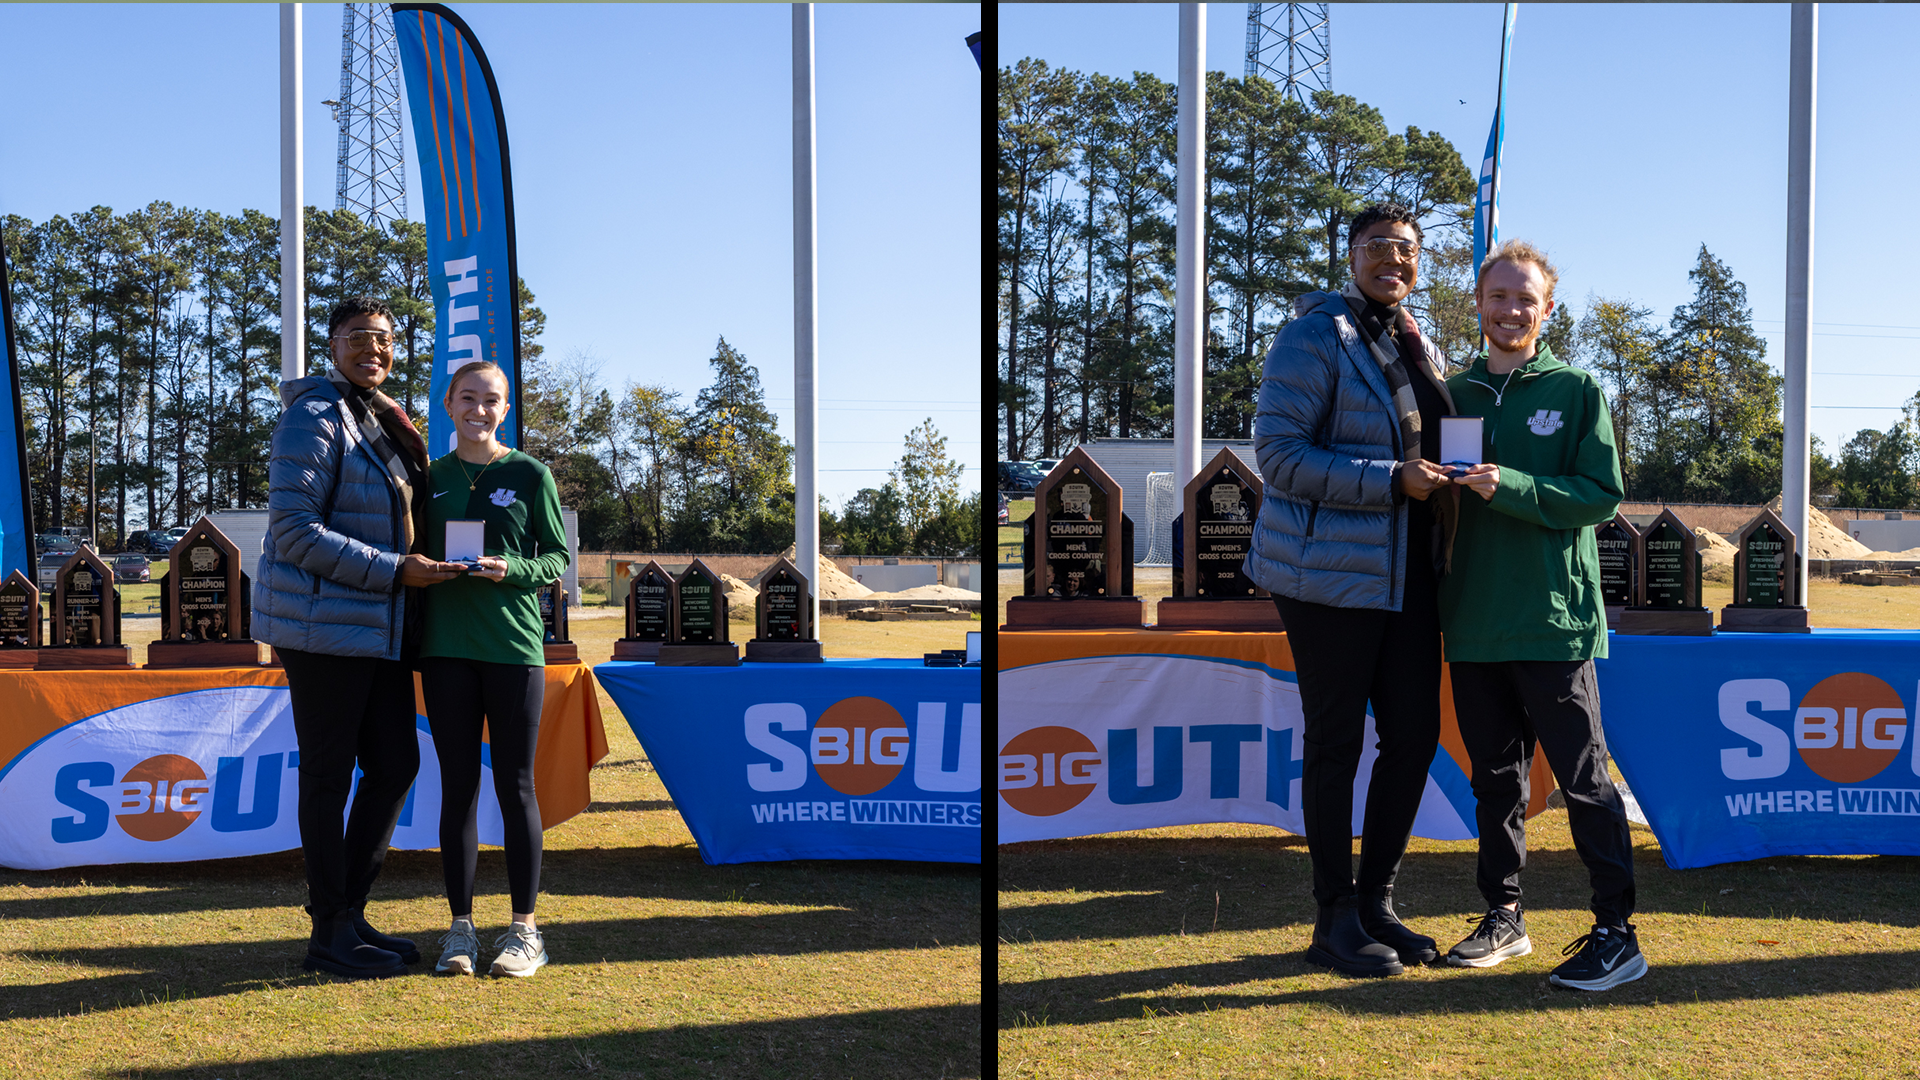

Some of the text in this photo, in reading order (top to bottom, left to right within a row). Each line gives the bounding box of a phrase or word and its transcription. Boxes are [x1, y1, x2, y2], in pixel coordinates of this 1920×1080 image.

[1527, 416, 1564, 429] Upstate
[1050, 525, 1102, 534] CHAMPION
[1200, 525, 1252, 535] CHAMPION
[1598, 540, 1628, 548] SOUTH
[1648, 541, 1681, 550] SOUTH
[1749, 541, 1782, 550] SOUTH
[681, 586, 710, 594] SOUTH
[1794, 706, 1908, 750] BIG
[810, 727, 910, 766] BIG
[998, 752, 1102, 790] BIG
[115, 778, 209, 816] BIG
[1724, 790, 1834, 817] WHERE
[751, 802, 982, 826] WHERE WINNERS
